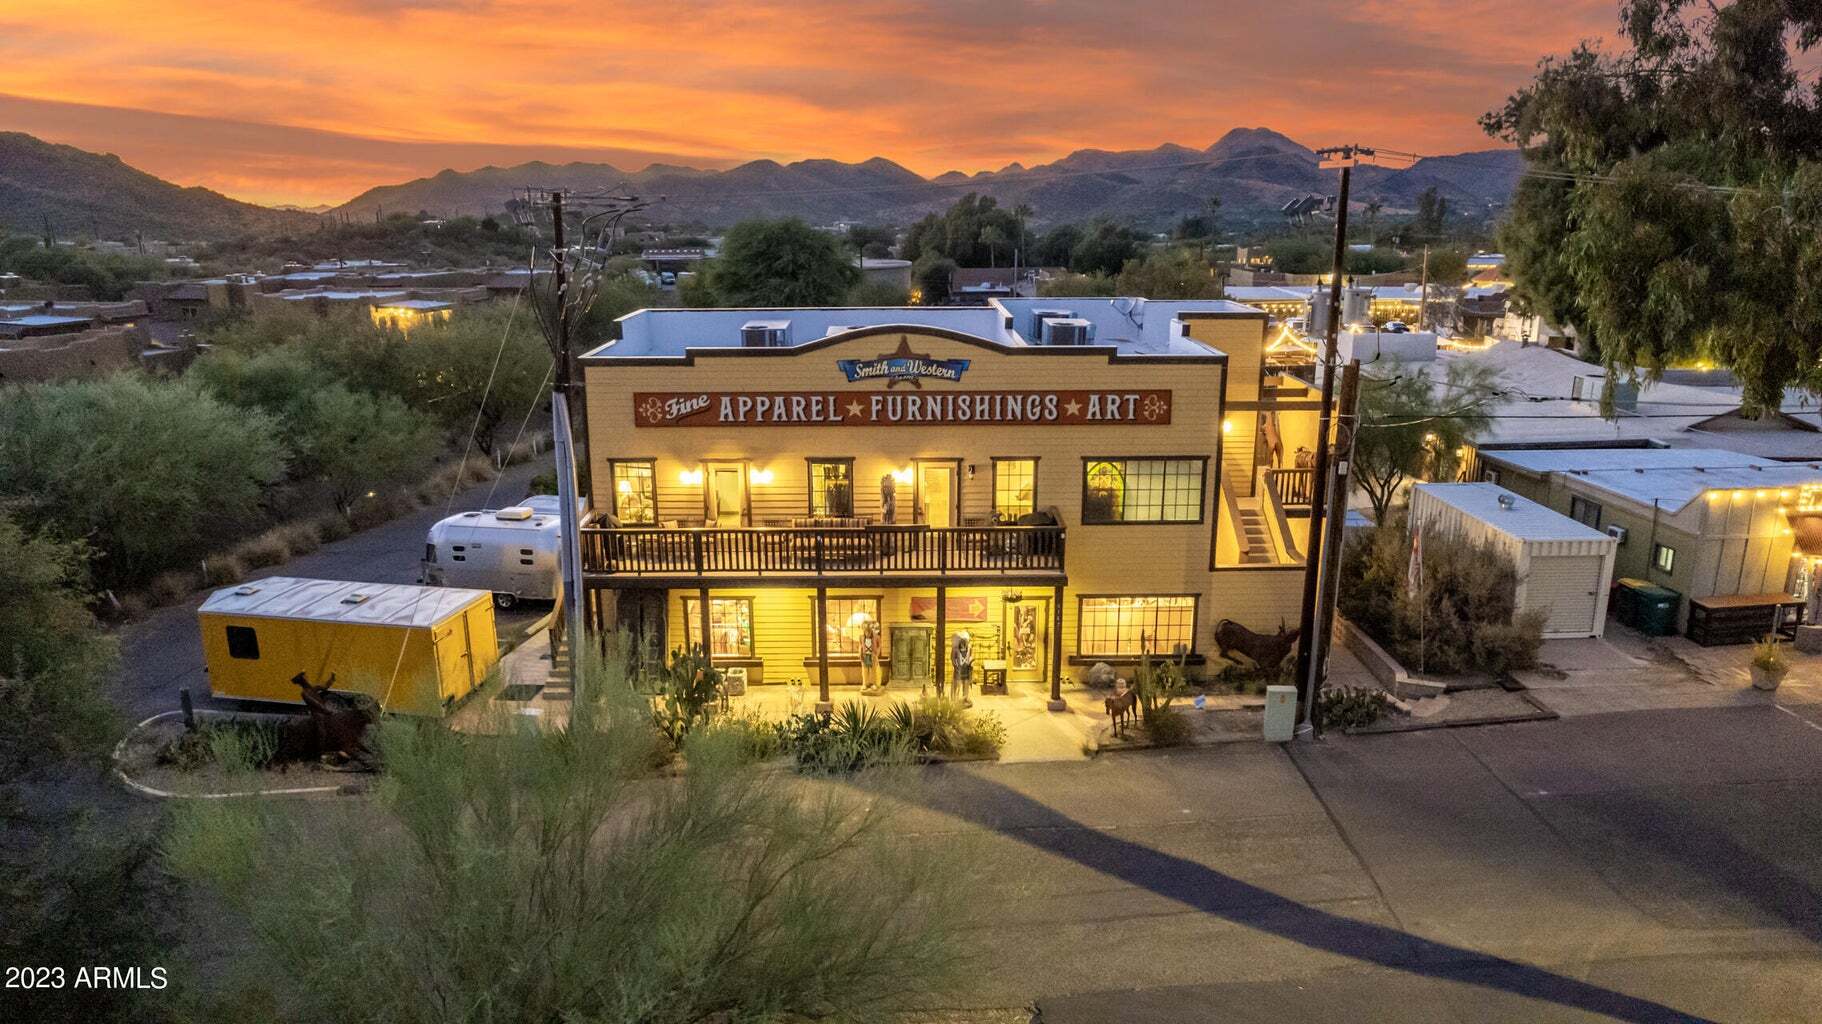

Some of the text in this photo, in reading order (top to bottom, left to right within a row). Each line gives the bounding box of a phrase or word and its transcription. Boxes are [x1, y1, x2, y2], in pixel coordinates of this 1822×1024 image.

[854, 359, 956, 379] Smith and Western
[665, 394, 1140, 423] Fine APPAREL FURNISHINGS ART
